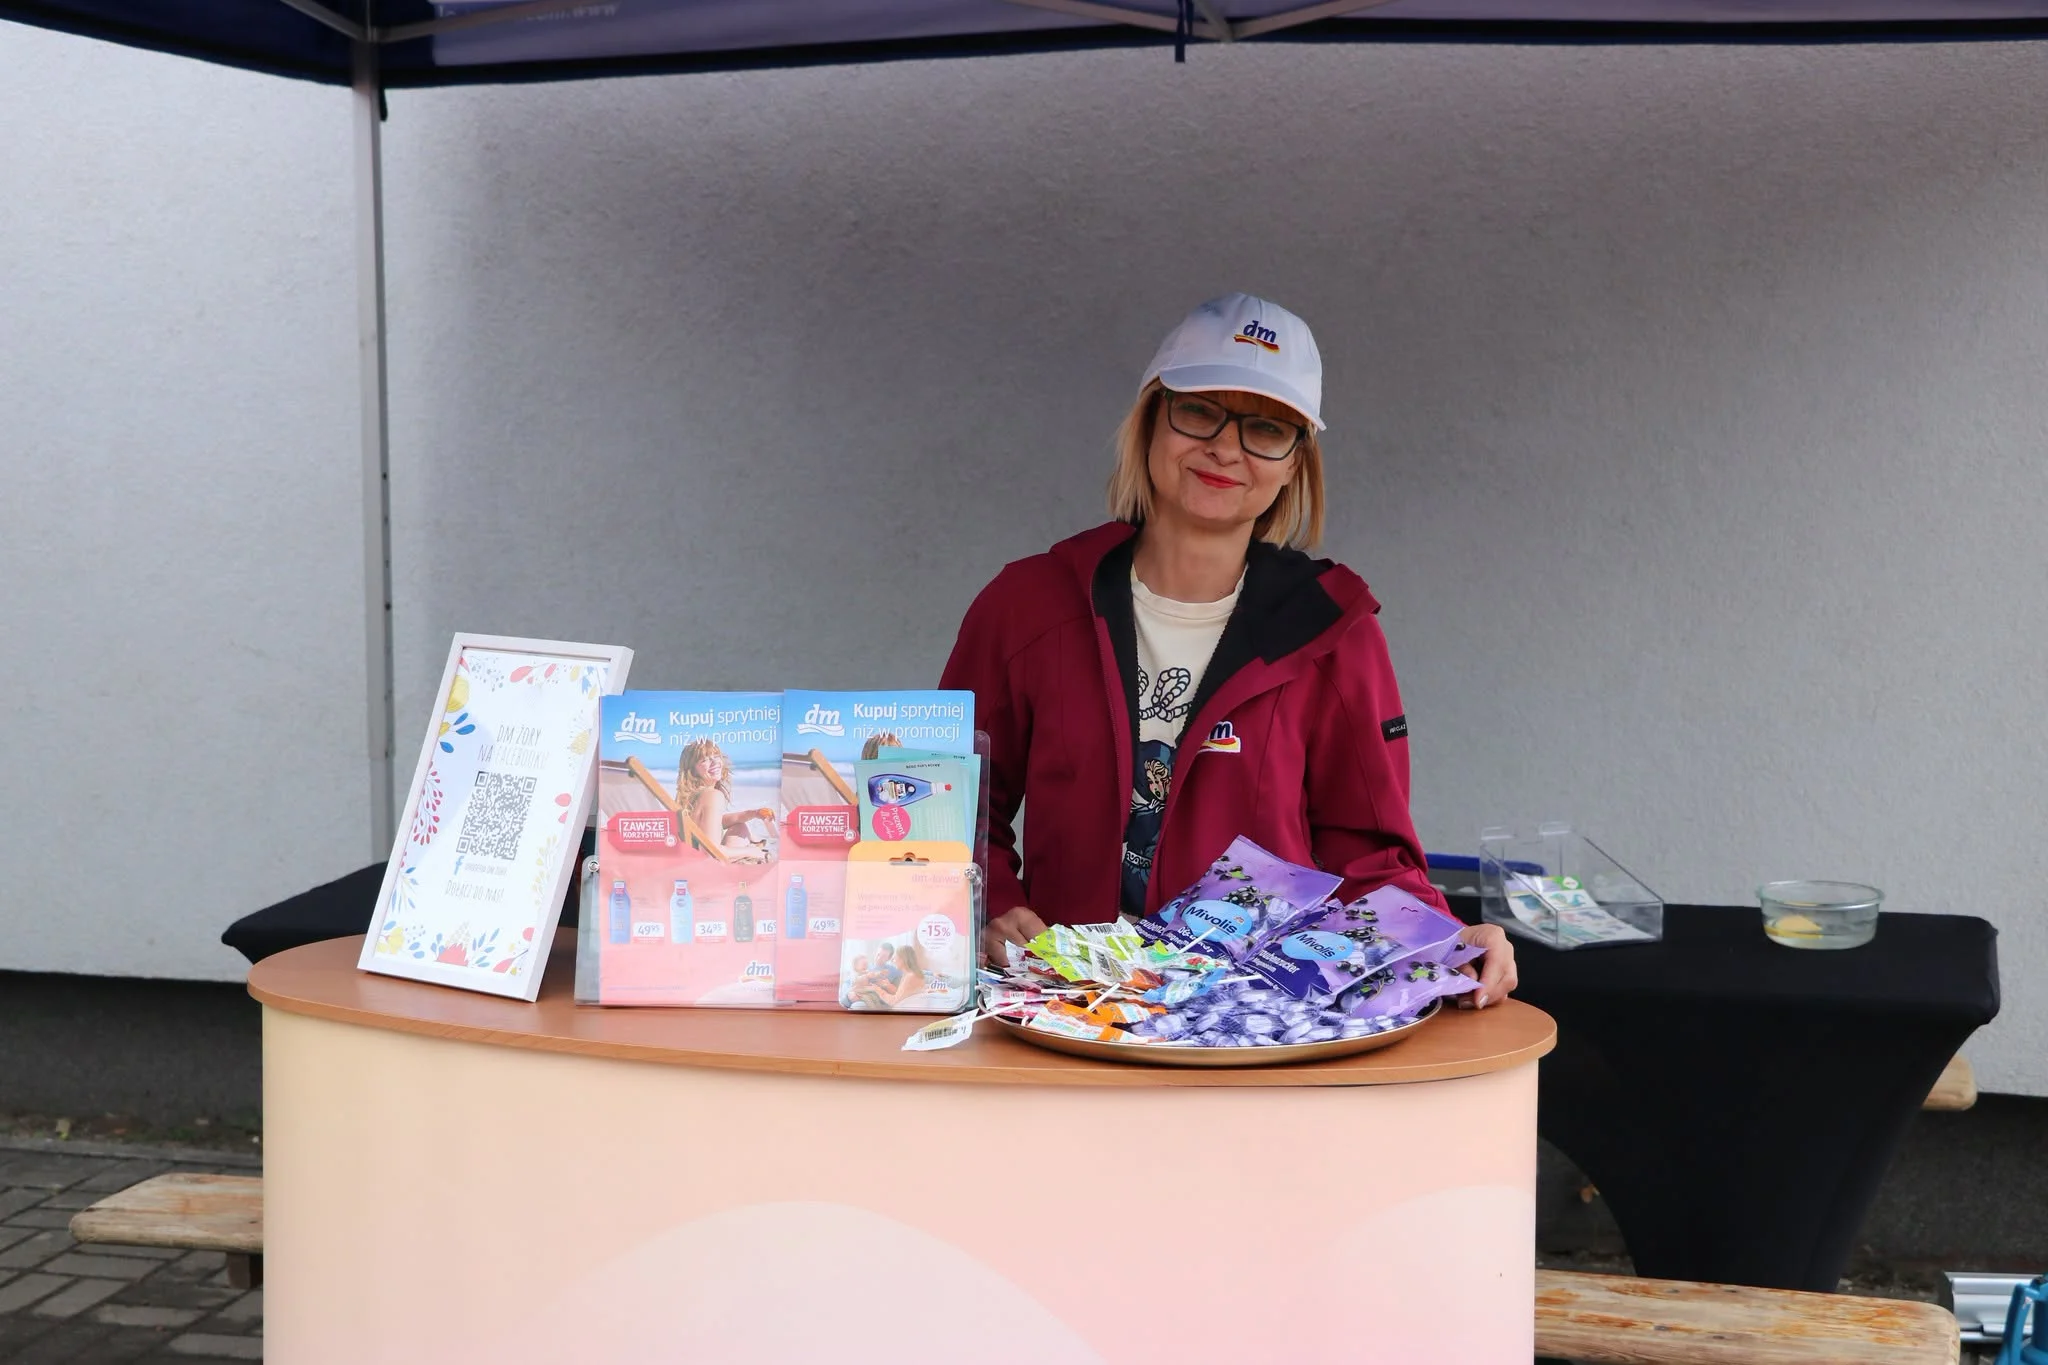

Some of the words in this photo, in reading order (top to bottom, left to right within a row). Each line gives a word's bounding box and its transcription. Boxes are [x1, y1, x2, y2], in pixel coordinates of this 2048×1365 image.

[1243, 320, 1277, 343] dm
[669, 709, 714, 728] Kupuj
[717, 705, 781, 725] sprytniej
[804, 703, 841, 725] dm
[853, 703, 898, 720] Kupuj
[901, 702, 964, 720] sprytniej
[620, 711, 657, 732] dm
[497, 724, 515, 744] DM
[516, 724, 542, 746] ŻORY
[669, 733, 691, 746] niż
[695, 732, 708, 744] w
[712, 726, 777, 747] promocji
[853, 725, 874, 739] niż
[879, 726, 893, 738] w
[895, 723, 960, 741] promocji
[1210, 723, 1231, 739] m
[477, 744, 494, 762] NA
[623, 821, 665, 831] ZAWSZE
[803, 815, 845, 825] ZAWSZE
[803, 825, 845, 833] KORZYSTNIE
[890, 807, 906, 836] Prezent
[623, 831, 665, 839] KORZYSTNIE
[1186, 906, 1238, 934] Mivolis
[921, 924, 951, 937] -15%
[1296, 933, 1336, 958] Mivolis
[746, 961, 770, 976] dm
[931, 980, 946, 990] dm
